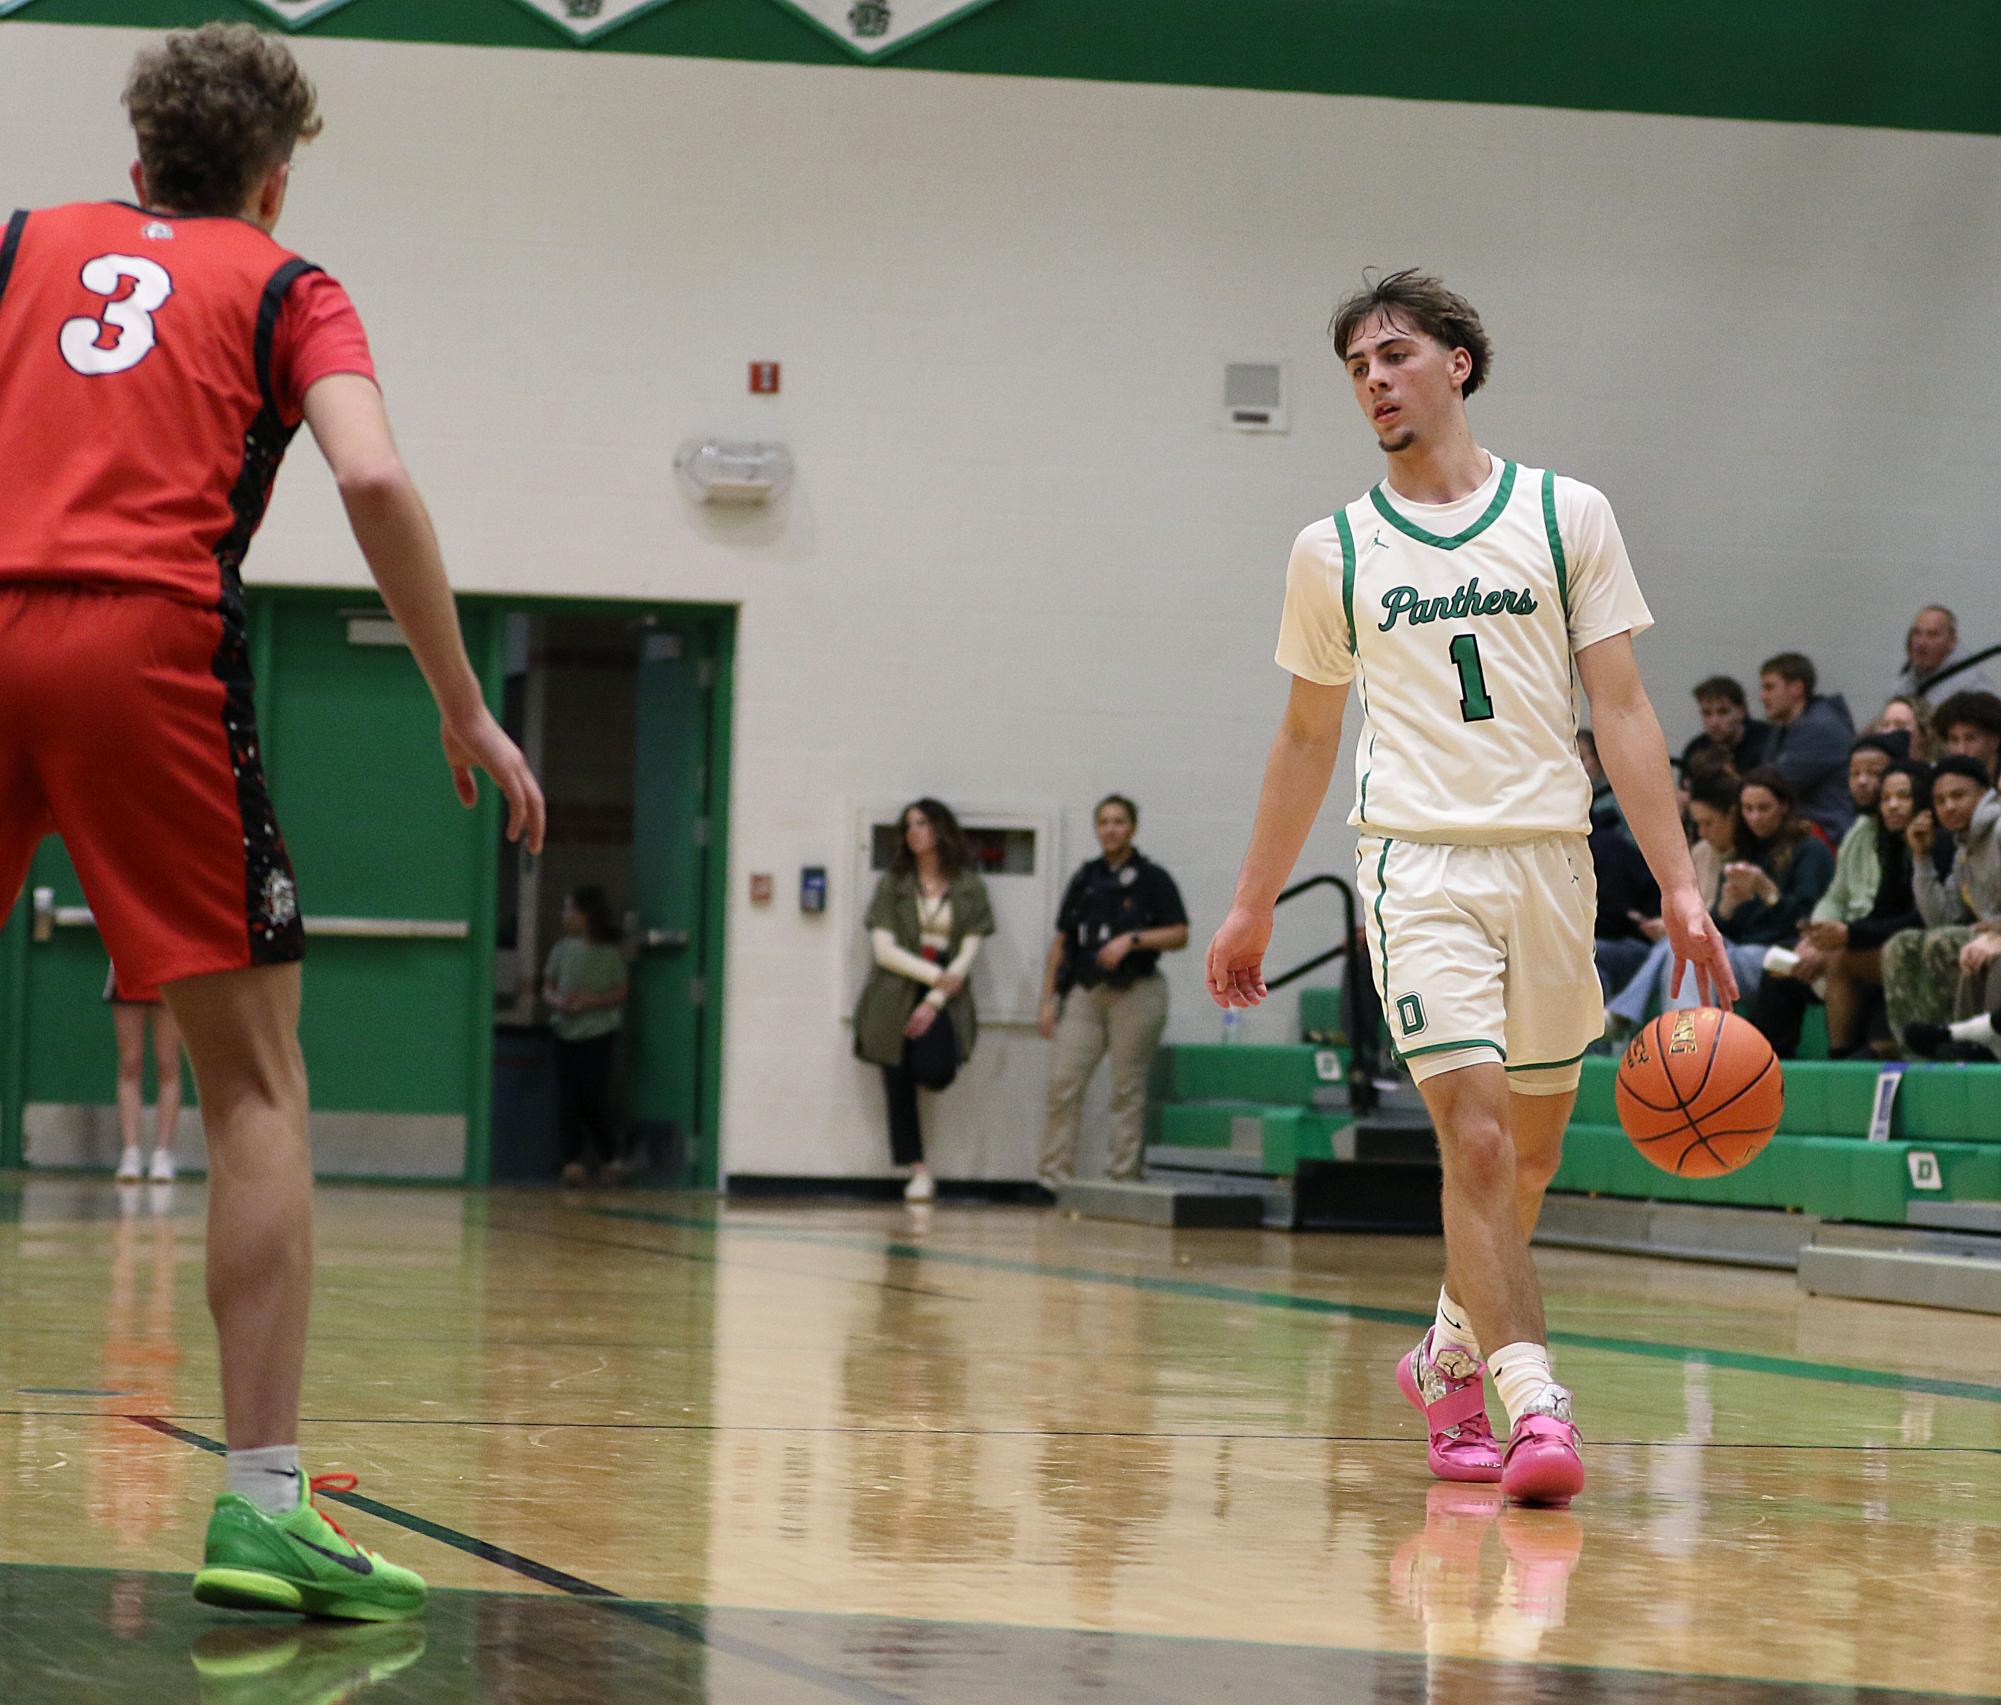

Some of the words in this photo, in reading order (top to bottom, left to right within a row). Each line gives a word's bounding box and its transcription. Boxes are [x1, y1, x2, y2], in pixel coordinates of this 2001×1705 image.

[58, 253, 174, 377] 3
[1379, 578, 1537, 631] Panthers
[1449, 634, 1494, 722] 1
[1394, 991, 1428, 1039] D
